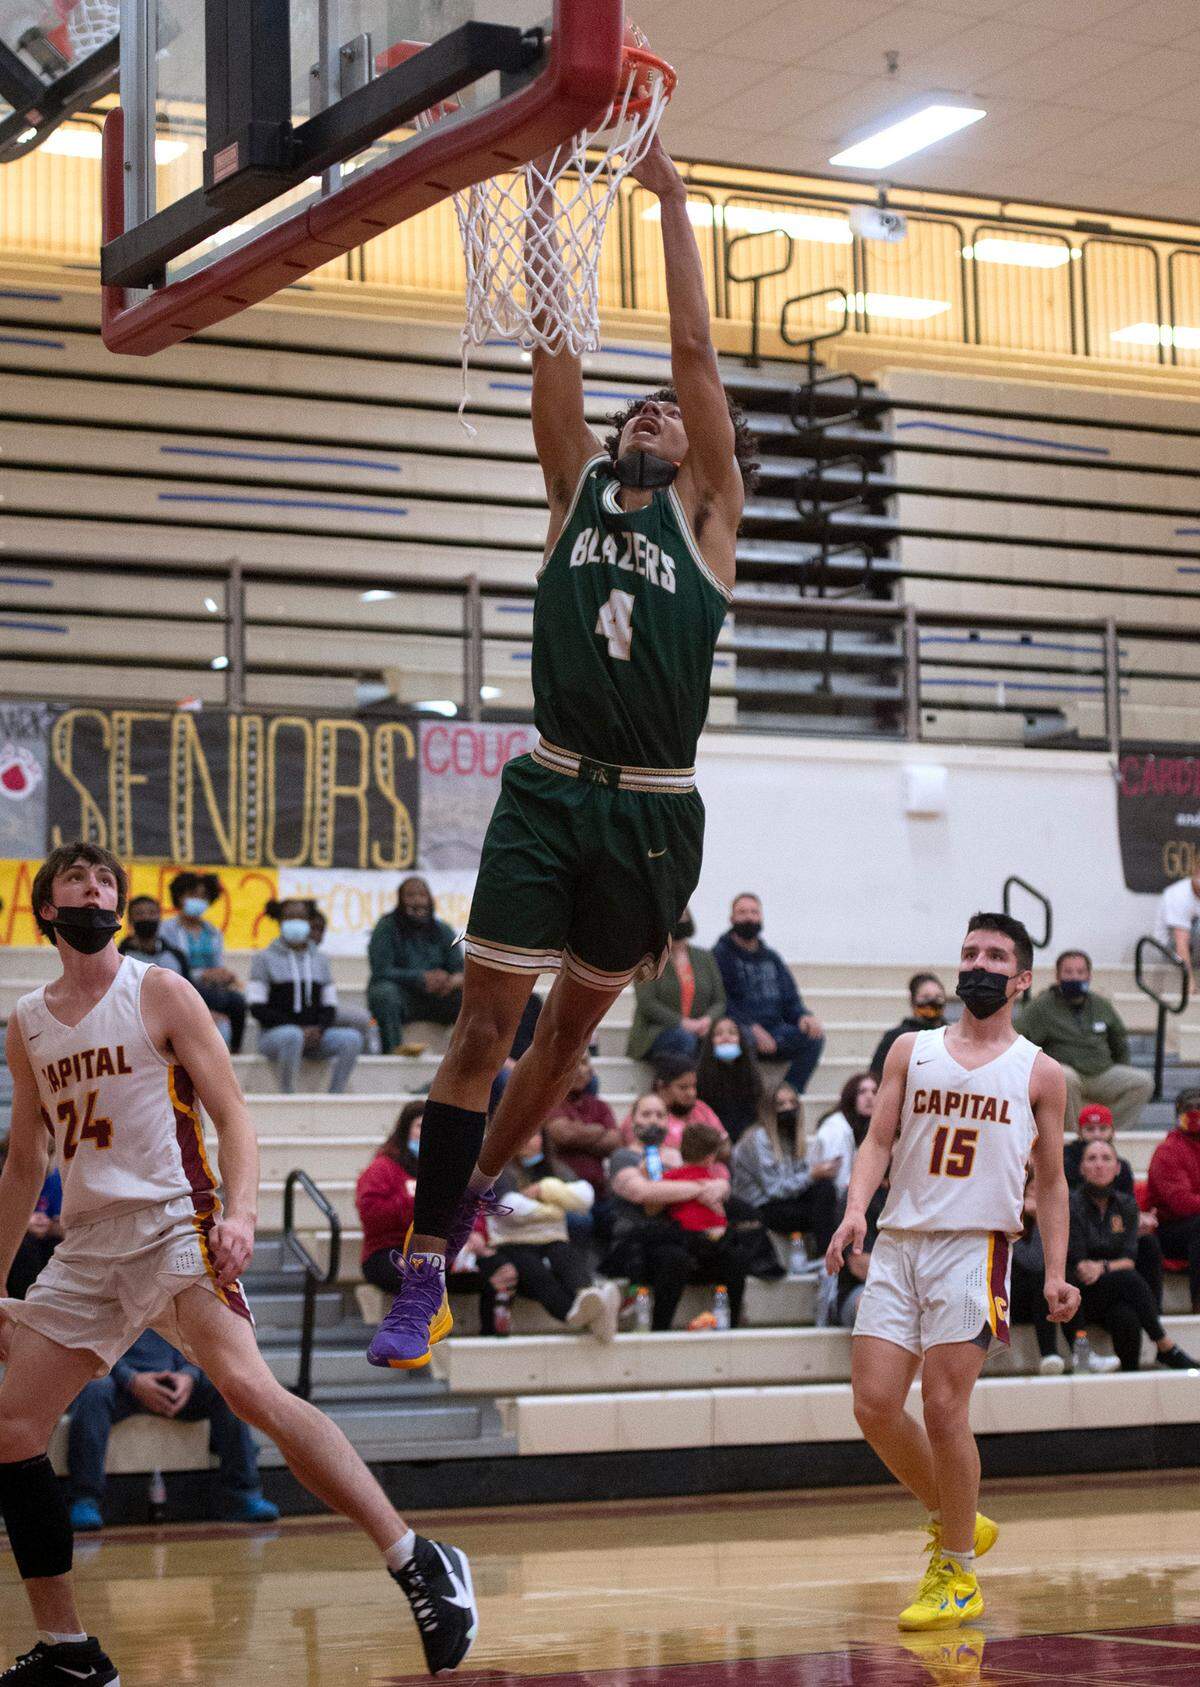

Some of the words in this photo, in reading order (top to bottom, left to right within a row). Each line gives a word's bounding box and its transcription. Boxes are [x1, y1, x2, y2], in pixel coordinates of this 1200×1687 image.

[569, 526, 677, 594] BLAZERS
[595, 588, 635, 661] 4
[52, 709, 415, 869] SENIORS
[42, 1045, 132, 1094] APITAL
[57, 1088, 114, 1162] 24
[913, 1089, 1012, 1125] CAPITAL
[929, 1125, 979, 1178] 15
